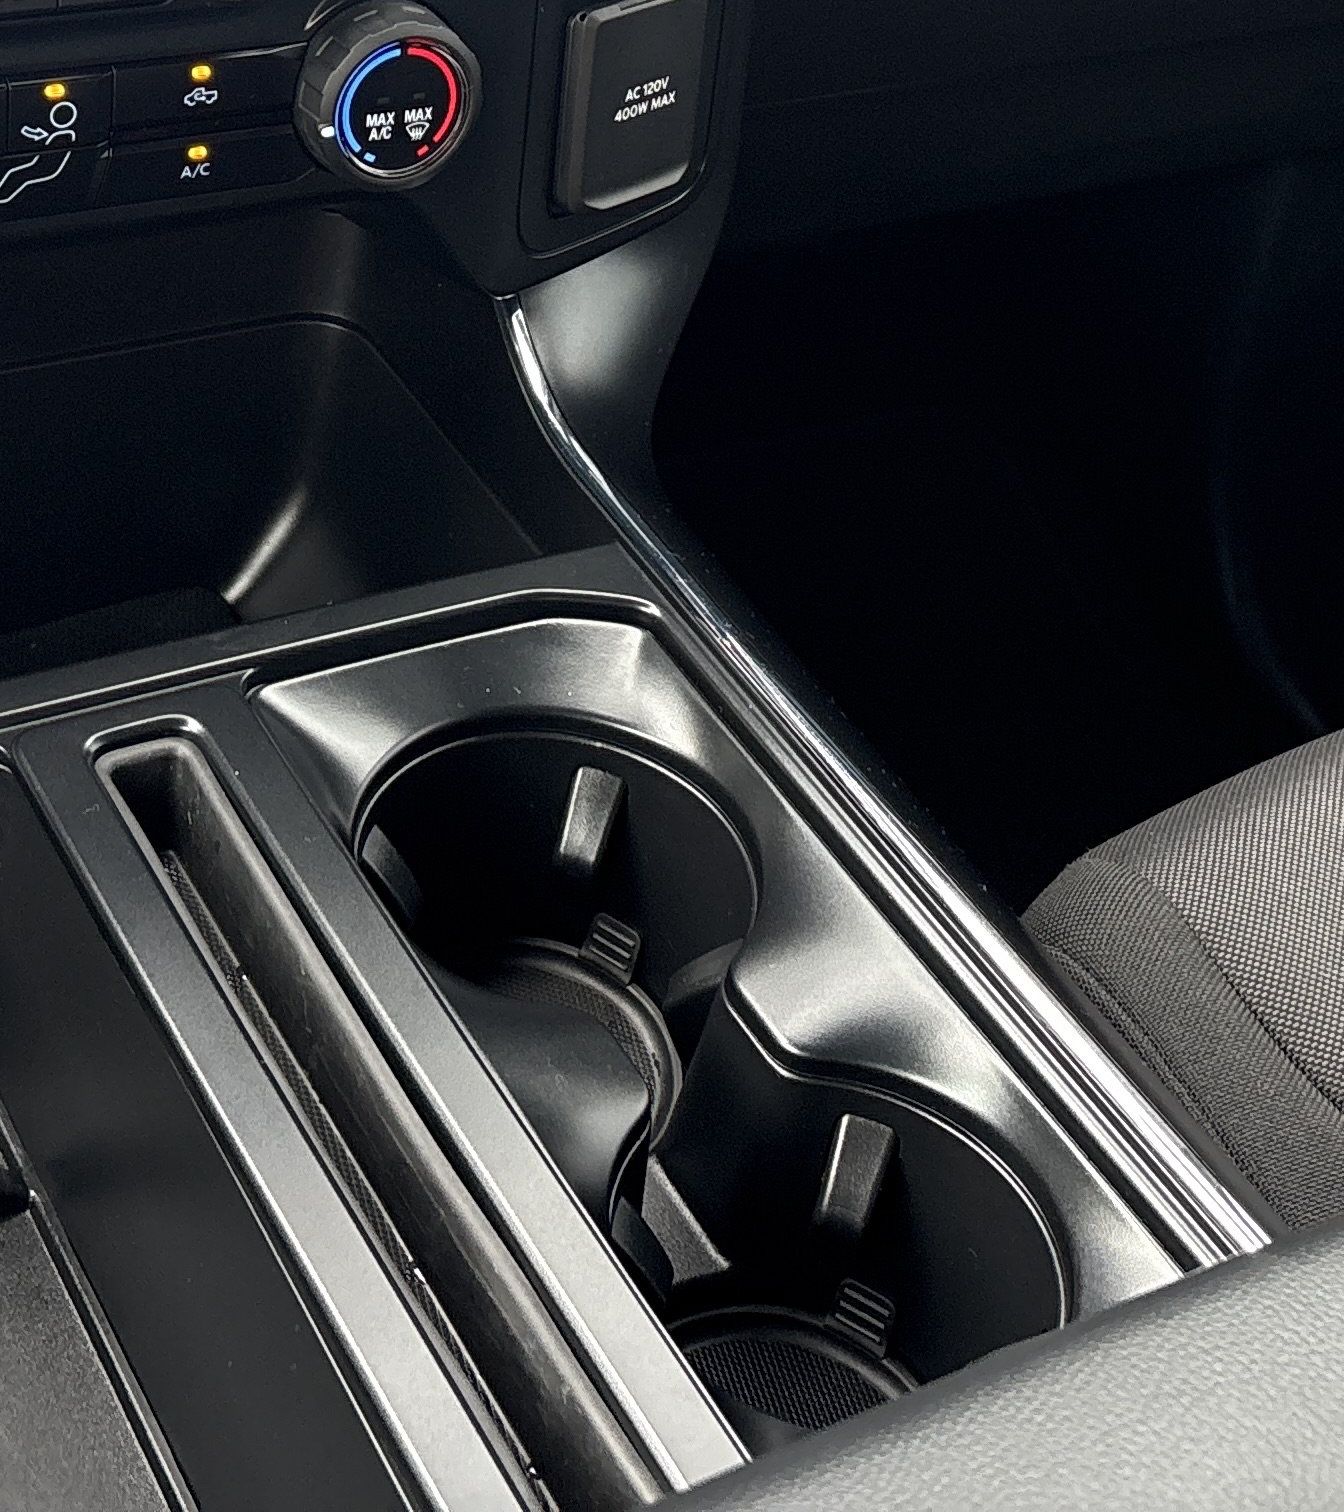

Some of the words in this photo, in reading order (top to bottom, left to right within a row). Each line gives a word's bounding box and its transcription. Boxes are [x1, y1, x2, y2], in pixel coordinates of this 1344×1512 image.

[624, 86, 642, 103] AC
[642, 75, 670, 96] 120V
[403, 106, 433, 124] MAX
[613, 100, 650, 122] 400W
[650, 90, 676, 111] MAX
[365, 111, 396, 128] MAX
[368, 126, 393, 142] A/C
[179, 162, 211, 180] A/C
